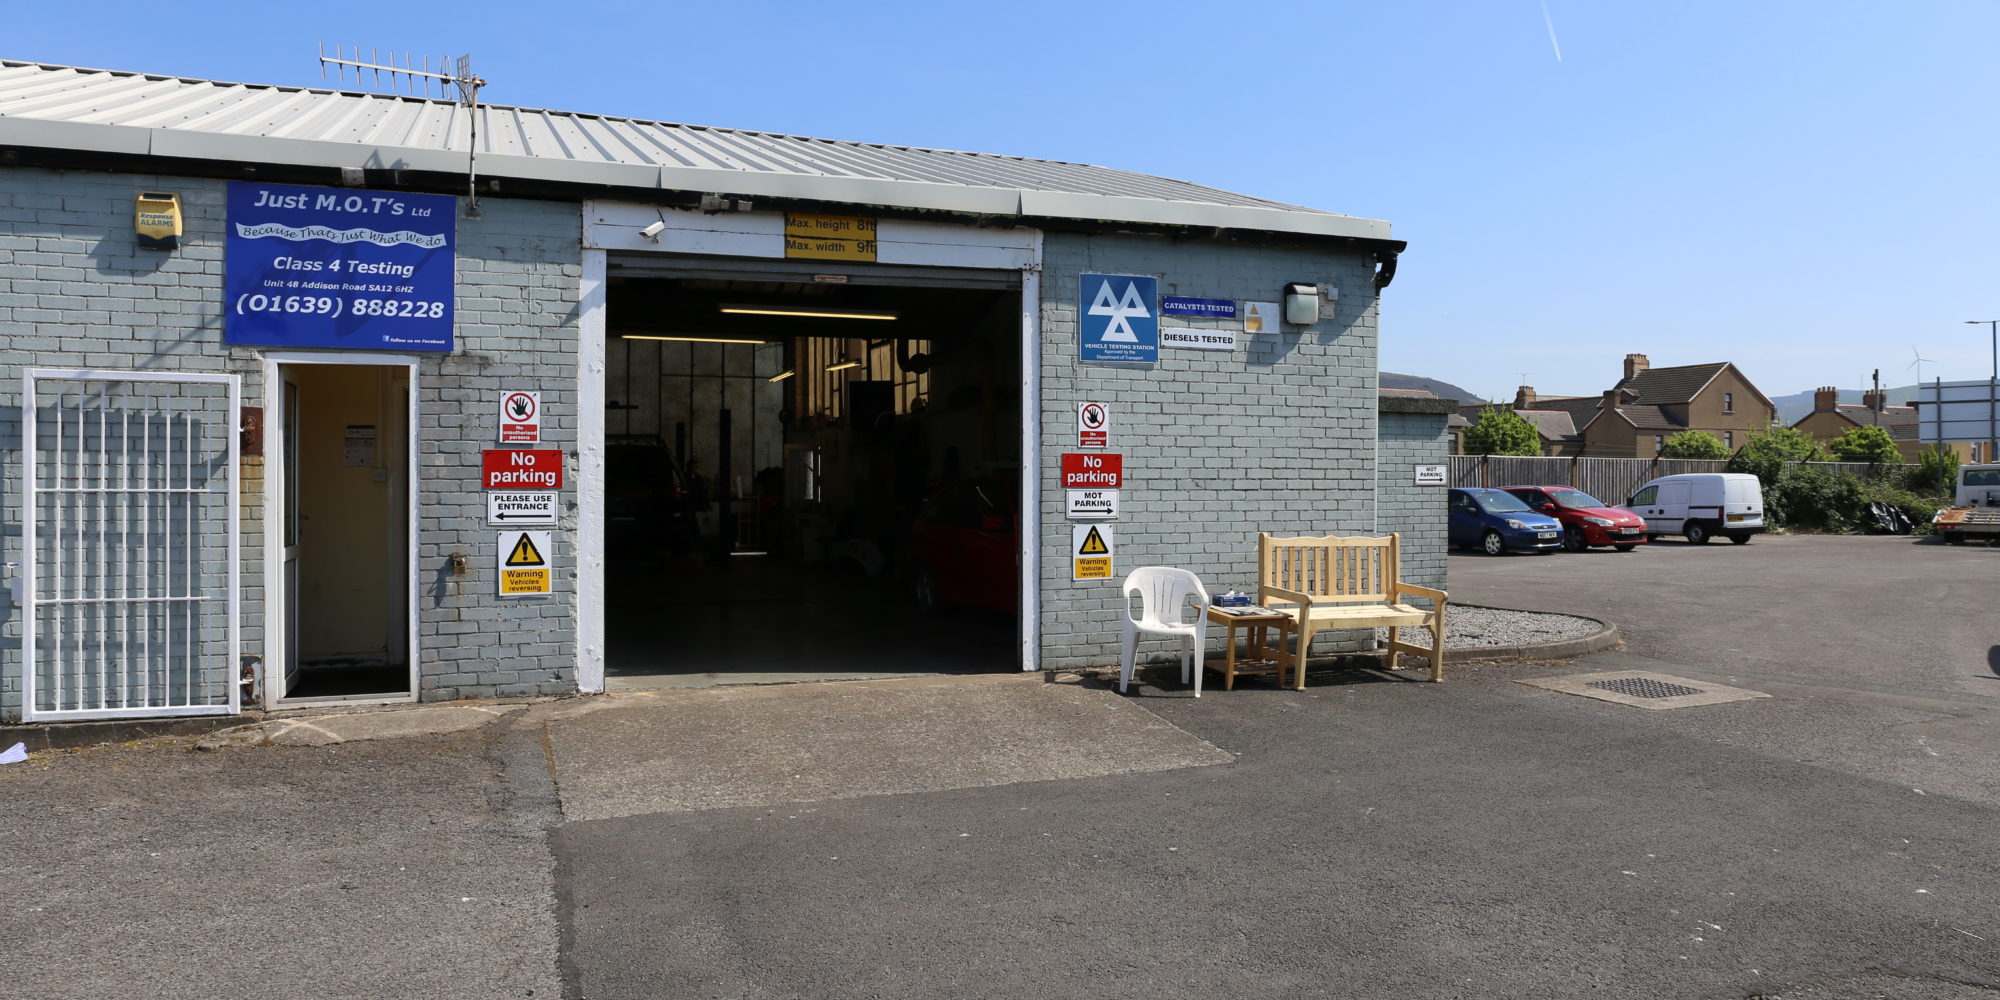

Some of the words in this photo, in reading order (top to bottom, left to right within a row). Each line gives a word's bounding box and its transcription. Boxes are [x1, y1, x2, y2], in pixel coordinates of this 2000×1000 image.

[254, 190, 308, 209] Just
[315, 194, 405, 215] M.O.T's
[411, 207, 431, 217] Ltd
[786, 218, 813, 228] Max.
[815, 219, 850, 232] height
[857, 219, 875, 231] 8ft
[243, 226, 298, 238] Because
[340, 230, 366, 242] Just
[369, 231, 402, 244] What
[406, 232, 424, 243] We
[425, 236, 443, 246] do
[786, 240, 813, 251] Max.
[815, 241, 845, 252] width
[857, 241, 874, 253] 9ft
[273, 256, 323, 271] Class
[328, 259, 341, 272] 4
[347, 260, 414, 278] Testing
[263, 279, 284, 288] Unit
[301, 281, 340, 290] Addison
[342, 283, 366, 291] Road
[368, 284, 392, 292] SA12
[351, 298, 445, 319] 888228
[1164, 302, 1206, 311] CATALYSTS
[1207, 304, 1234, 313] TESTED
[1164, 333, 1199, 342] DIESELS
[1201, 335, 1233, 344] TESTED
[511, 451, 536, 466] No
[1083, 455, 1102, 468] No
[490, 469, 556, 486] parking
[1067, 471, 1117, 486] parking
[497, 502, 549, 510] ENTRANCE
[1079, 558, 1108, 566] Warning
[506, 570, 544, 579] Warning
